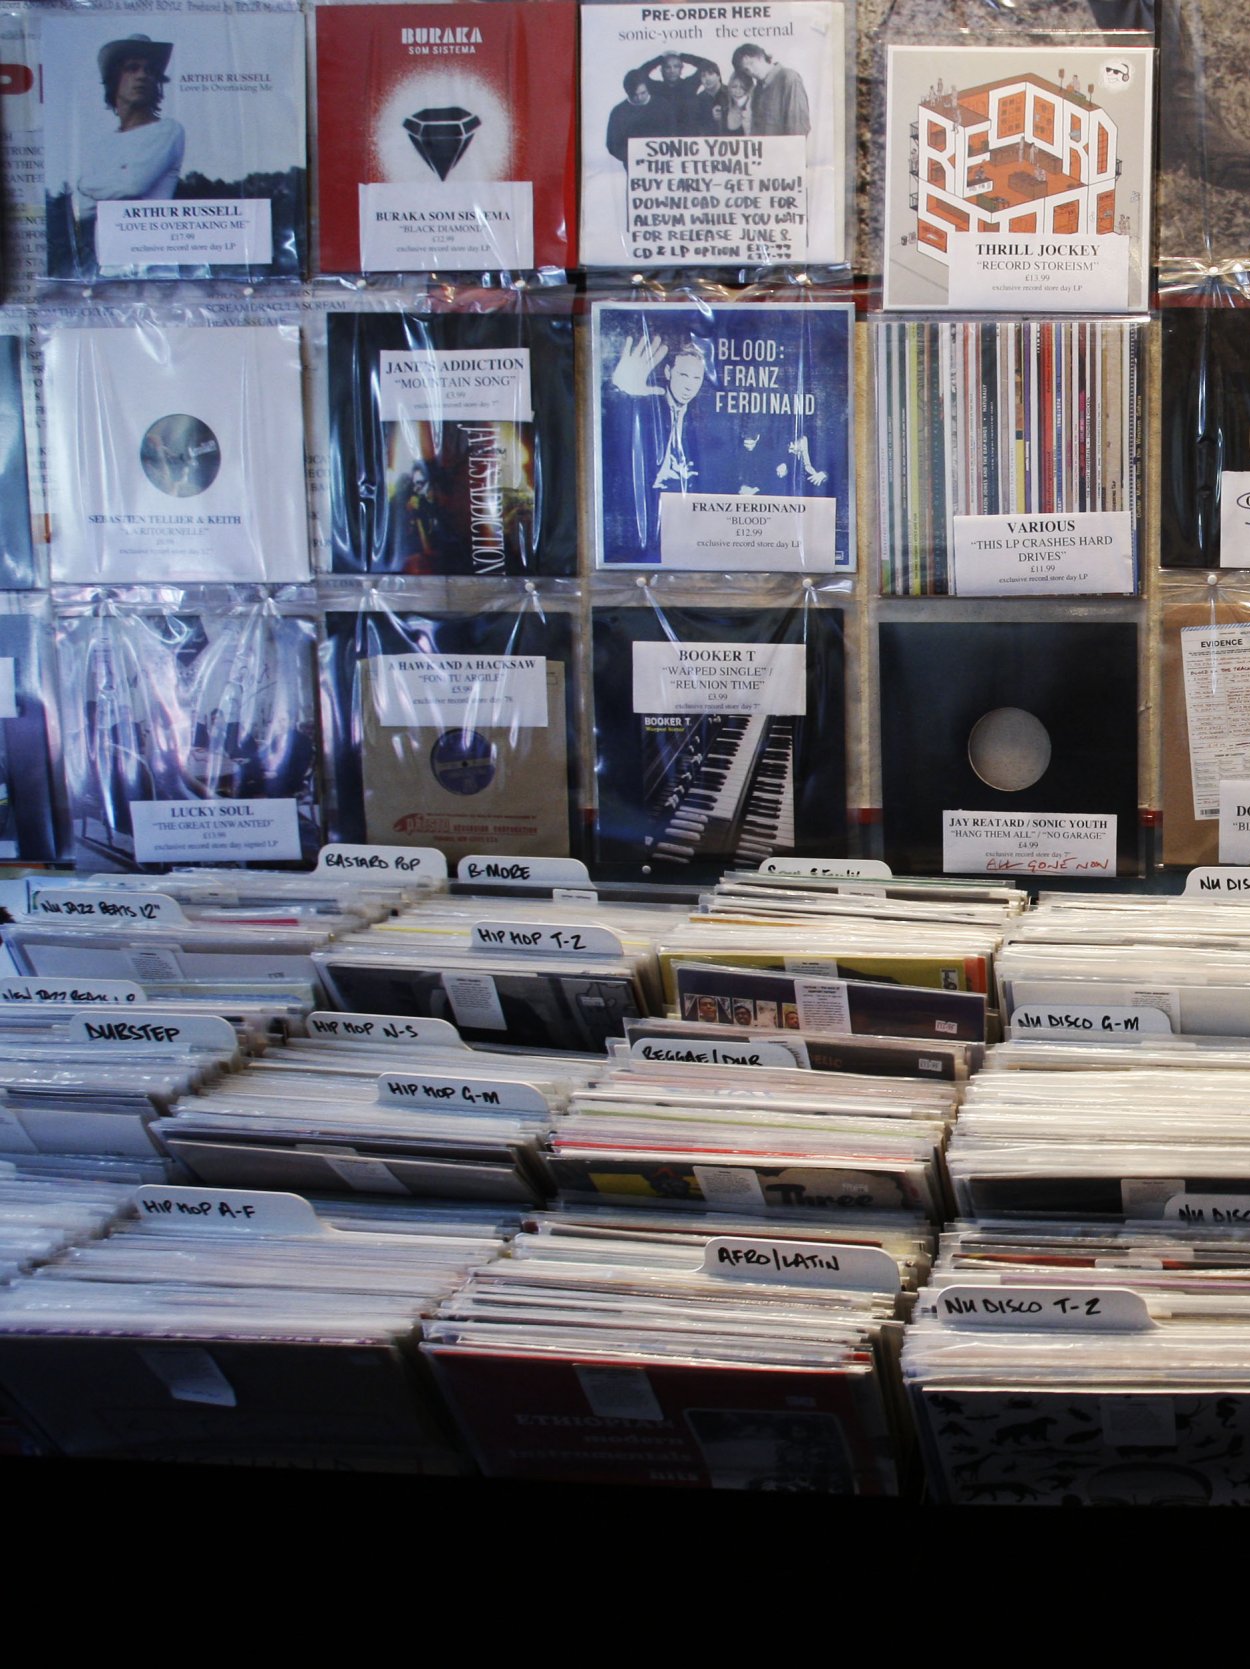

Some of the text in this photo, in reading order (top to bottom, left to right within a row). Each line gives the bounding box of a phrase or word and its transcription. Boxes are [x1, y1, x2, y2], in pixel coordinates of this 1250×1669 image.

[642, 6, 771, 21] PRE-ORDER HERE
[401, 27, 483, 45] BURAKA
[618, 22, 794, 43] sonic-youth the eternal
[409, 45, 476, 54] SOM SISTEMA
[180, 74, 272, 82] ARTHUR RUSSELL
[646, 139, 762, 159] SONIC YOUTH
[122, 206, 242, 218] ARTHUR RUSSELL
[116, 220, 250, 231] "LOVE IS OVERTAKING ME"
[976, 244, 1101, 257] THRILL JOCKEY
[977, 261, 1099, 271] "RECORD STOREISM"
[1025, 274, 1050, 282] £13.99
[718, 338, 785, 361] BLOOD:
[724, 365, 779, 388] FRANZ
[715, 392, 815, 416] FERDINAND
[692, 502, 806, 513] FRANZ FERDINAND
[726, 516, 771, 525] "BLOOD"
[1008, 520, 1075, 534] VARIOUS
[736, 528, 763, 537] £12.99
[971, 536, 1113, 550] "THIS LP CRASHES HARD
[1018, 551, 1066, 562] DRIVES"
[1031, 565, 1055, 573] £11.99
[999, 576, 1027, 584] exclusive
[1066, 574, 1077, 582] day
[1201, 639, 1243, 648] EVIDENCE
[679, 650, 756, 662] BOOKER T
[171, 806, 254, 818] LUCKY SOUL
[949, 818, 1107, 828] JAY REATARD / SONIC YOUTH
[325, 853, 421, 871] BASTARD POP
[468, 864, 531, 880] B-MORE
[1200, 877, 1222, 891] NU
[63, 903, 95, 914] JAZZ
[99, 902, 137, 917] BEATS
[478, 929, 587, 950] HIP HOP T-Z
[1017, 1013, 1140, 1030] NU DISCO G-M
[84, 1023, 180, 1042] DUBSTEP
[313, 1020, 419, 1038] HIP HOP N-S
[387, 1082, 501, 1105] HIP HOP G-M
[143, 1200, 256, 1219] HIP HOP A-F
[717, 1246, 840, 1273] AFRO/LATIN
[945, 1297, 1102, 1317] NU DISCO T-Z
